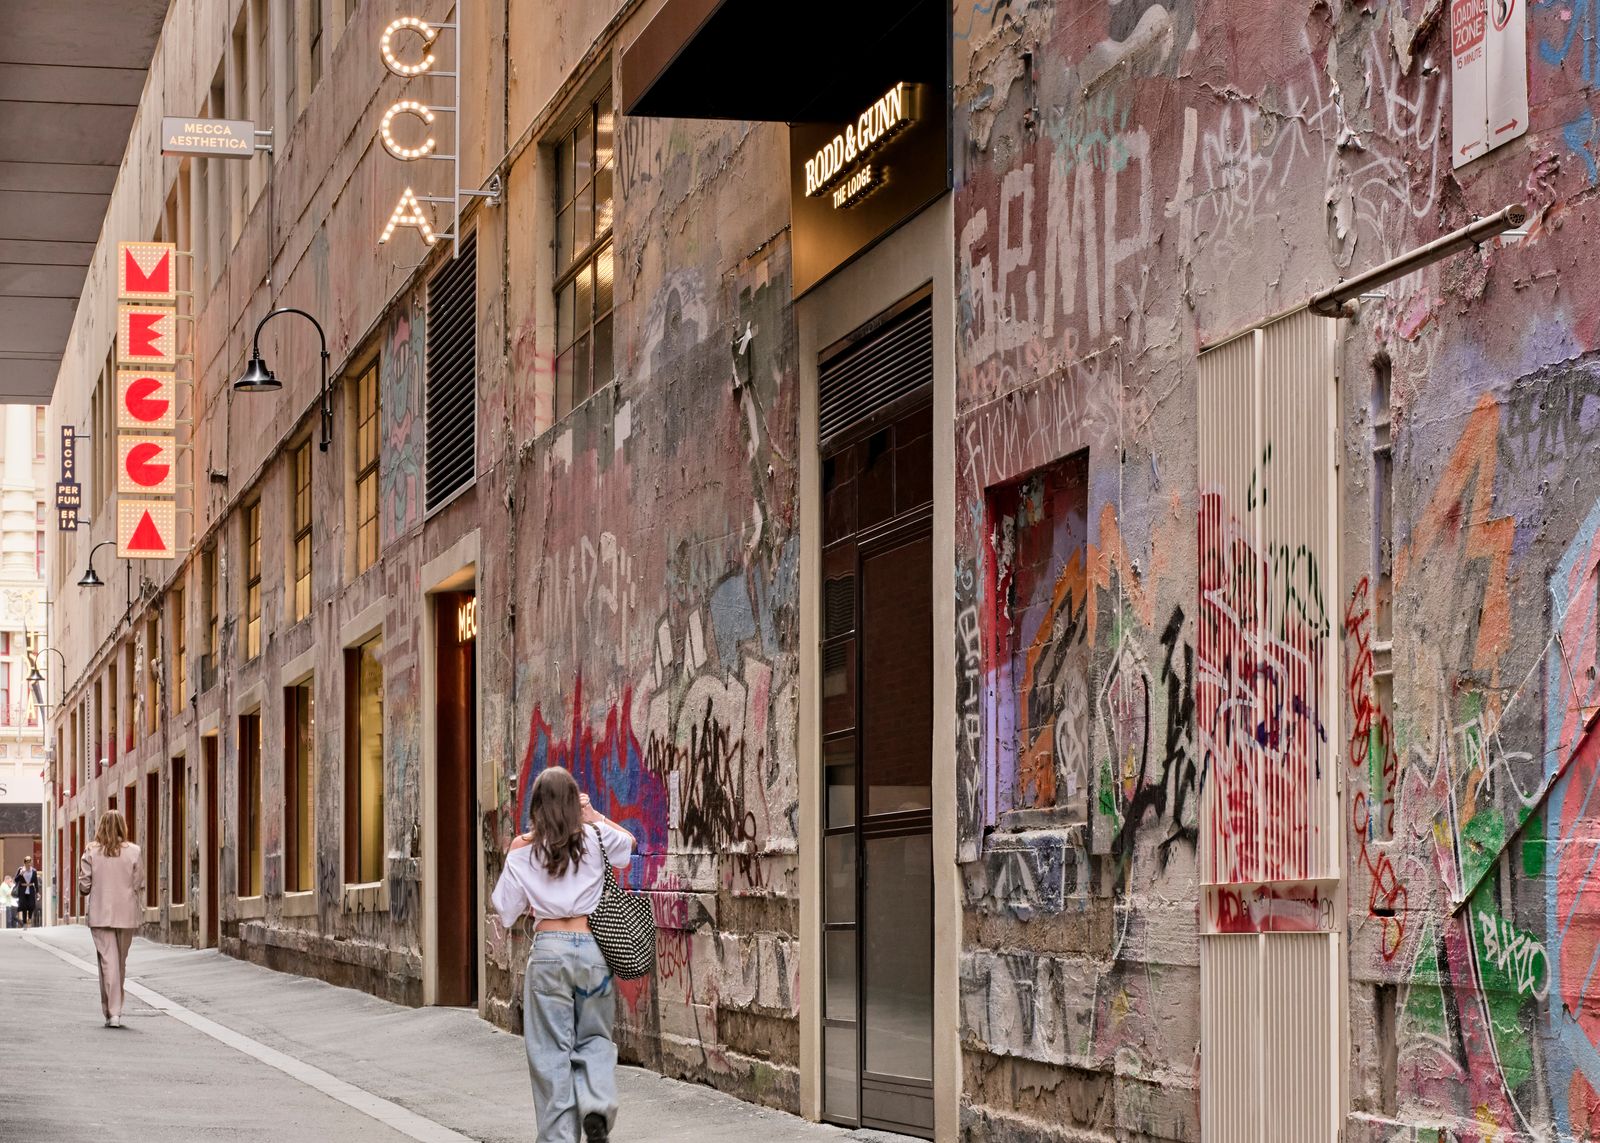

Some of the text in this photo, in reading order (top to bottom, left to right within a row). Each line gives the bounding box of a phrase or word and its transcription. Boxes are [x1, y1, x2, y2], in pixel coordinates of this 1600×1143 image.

[1453, 0, 1486, 29] LOADING
[1455, 16, 1483, 50] ZONE
[1456, 46, 1483, 71] 15 MINUTE
[184, 123, 232, 135] MECCA
[169, 135, 248, 149] AESTHETICA
[833, 164, 872, 209] THE LODGE
[124, 246, 171, 551] MECCA
[63, 428, 73, 478] MECCA
[58, 486, 79, 494] PER
[58, 496, 79, 504] FUM
[61, 510, 76, 519] ER
[62, 519, 76, 528] IA
